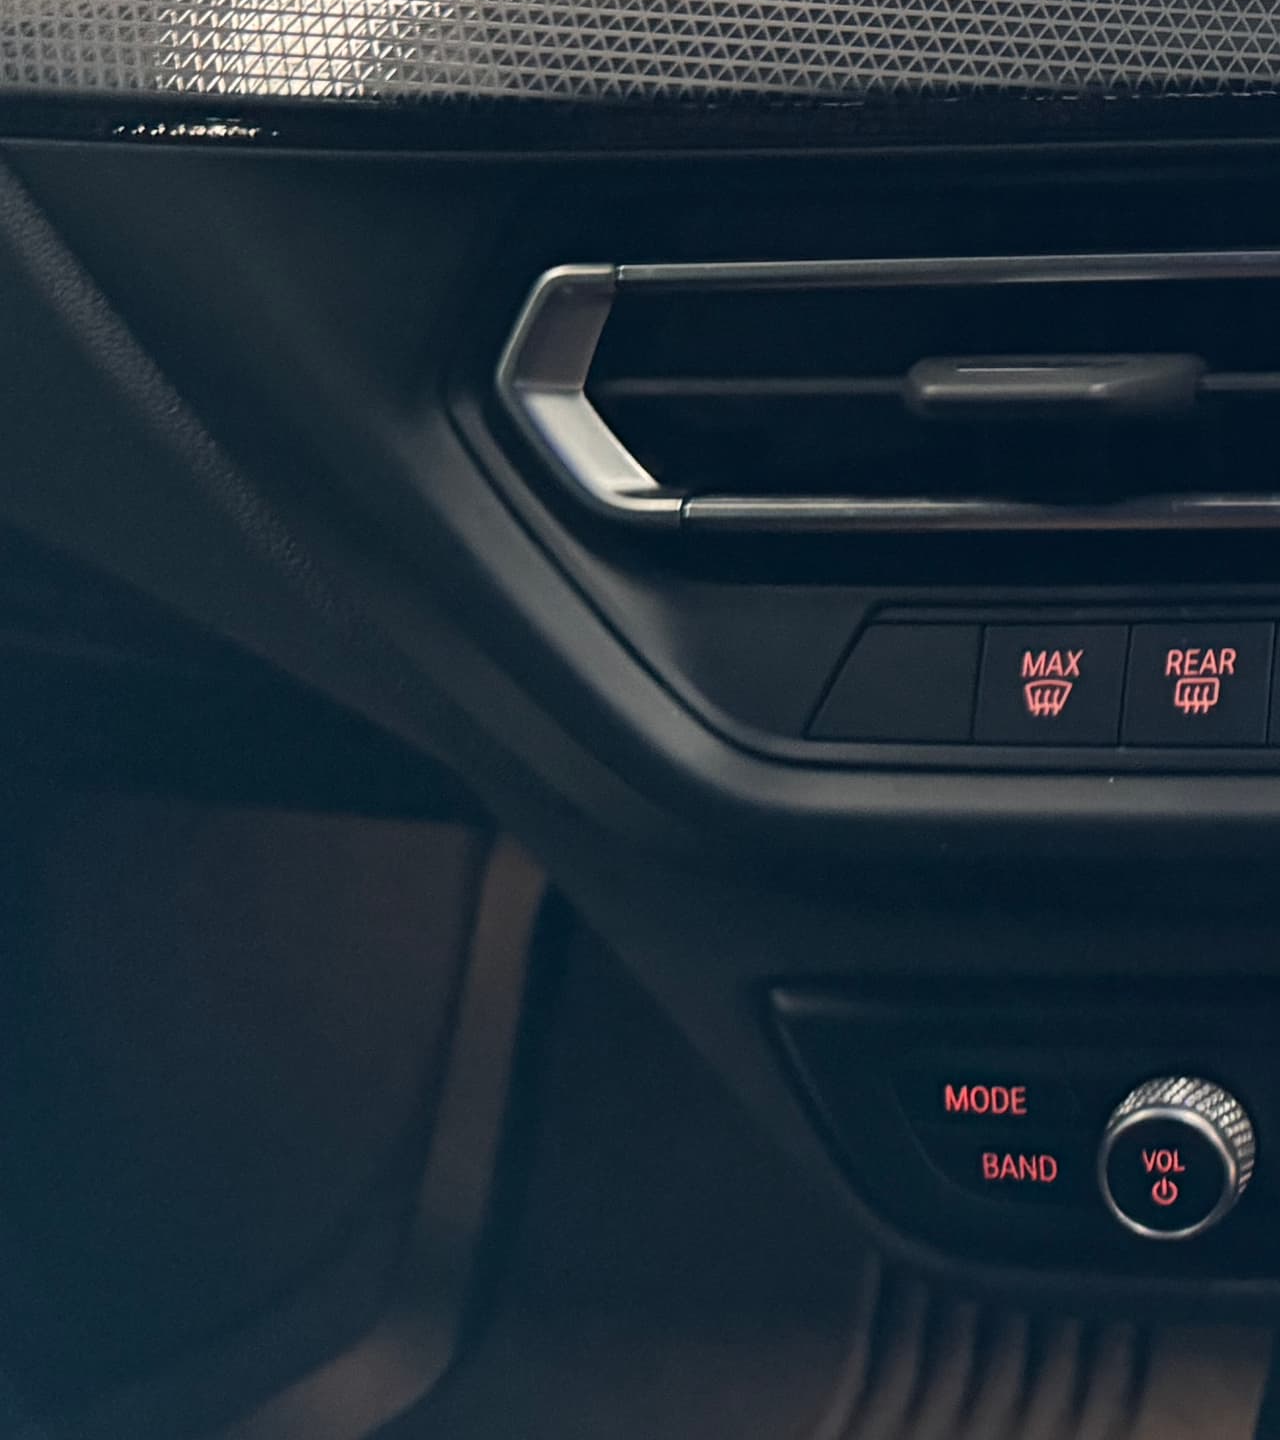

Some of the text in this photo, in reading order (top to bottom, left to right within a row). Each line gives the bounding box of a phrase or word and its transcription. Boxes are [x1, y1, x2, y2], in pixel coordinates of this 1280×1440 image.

[1022, 650, 1083, 677] MAX
[1165, 648, 1237, 676] REAR
[945, 1085, 1026, 1115] MODE
[982, 1153, 1058, 1182] BAND
[1143, 1150, 1185, 1173] VOL
